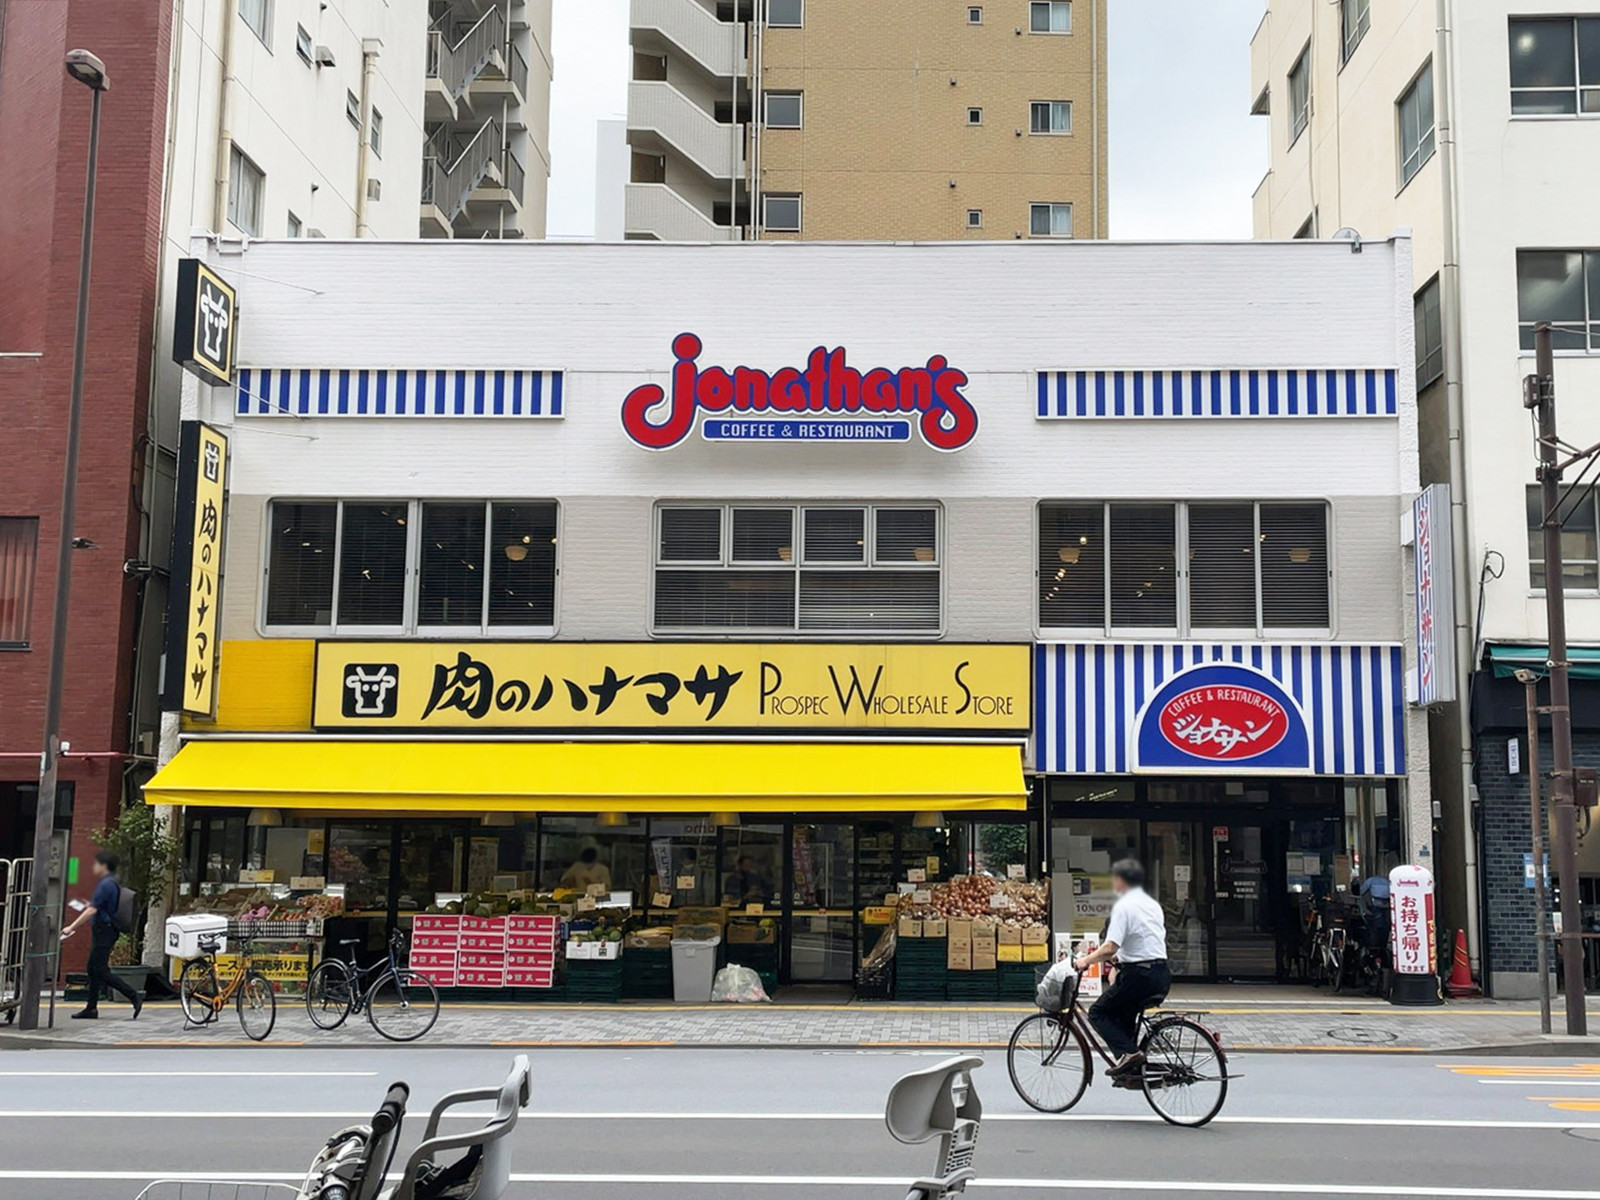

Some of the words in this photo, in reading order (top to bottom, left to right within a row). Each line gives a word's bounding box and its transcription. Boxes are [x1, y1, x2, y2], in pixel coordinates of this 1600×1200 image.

[720, 423, 775, 437] COFFEE
[781, 424, 793, 437] &
[799, 424, 894, 438] RESTAURANT
[191, 498, 216, 700] 肉のハナマサ
[1418, 506, 1432, 687] ジョナサン
[420, 651, 743, 721] 肉のハナマサ
[1168, 691, 1203, 717] COFFEE
[1206, 690, 1214, 701] &
[1217, 689, 1281, 718] RESTAURANT
[1172, 713, 1274, 756] ジョナサン
[1401, 896, 1420, 964] お持ち帰り
